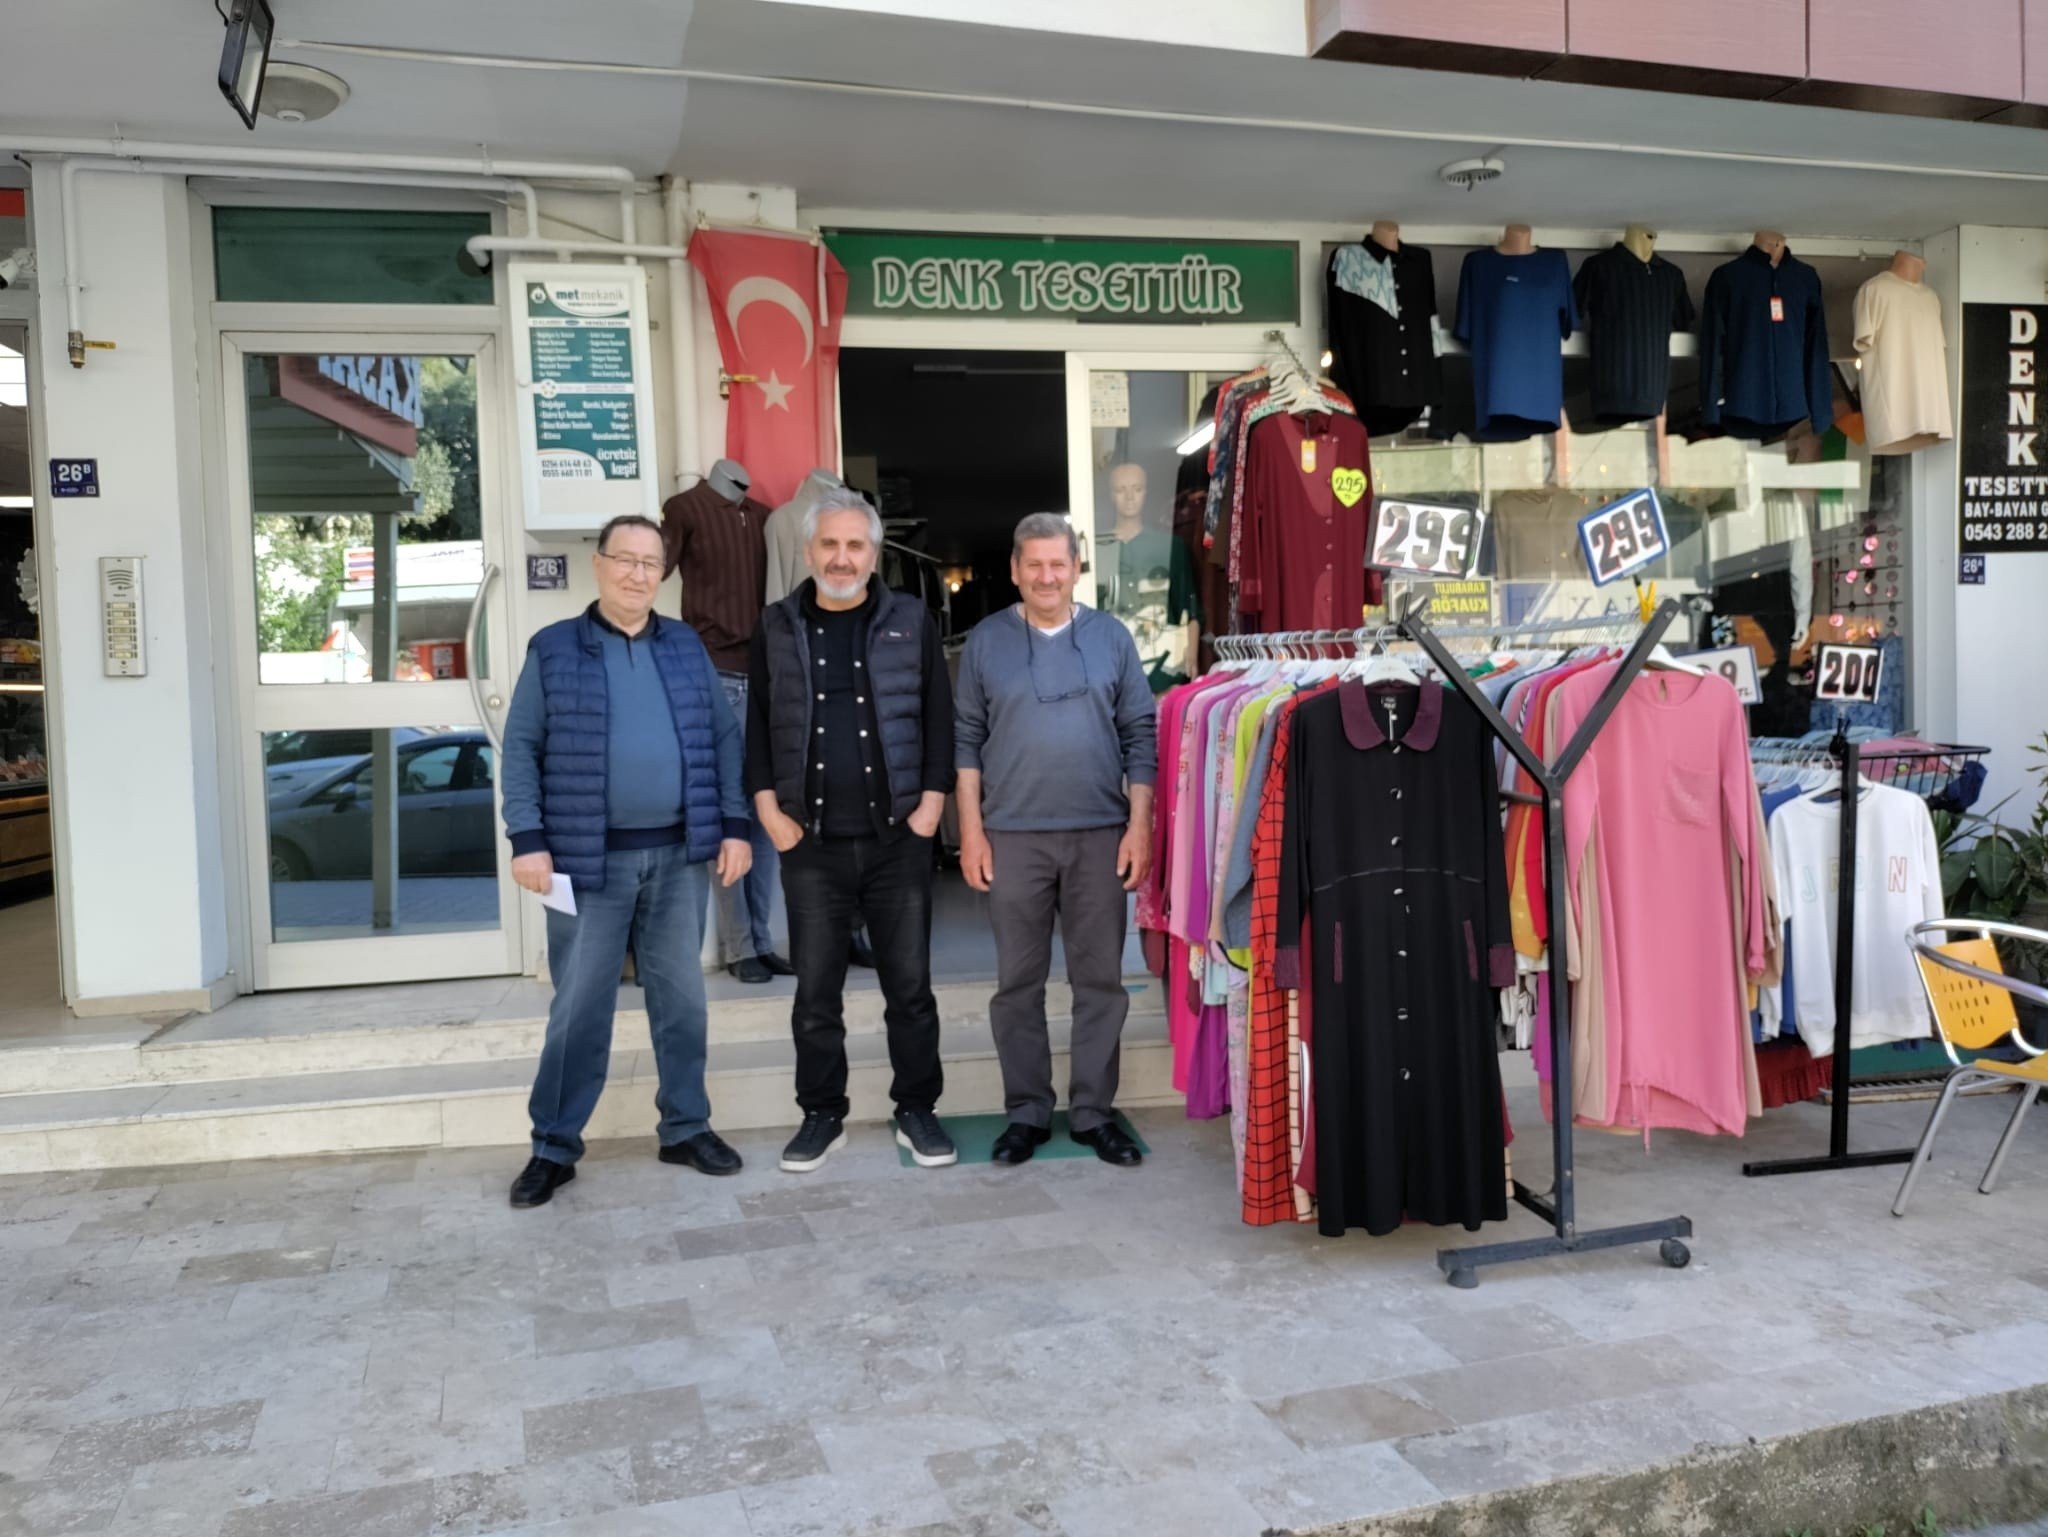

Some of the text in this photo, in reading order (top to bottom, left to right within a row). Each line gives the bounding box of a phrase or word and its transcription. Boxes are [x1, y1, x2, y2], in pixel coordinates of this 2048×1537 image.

[556, 289, 624, 300] met mekanik
[872, 254, 1243, 313] DENK TESETTÜR
[2006, 310, 2039, 466] DENK
[596, 447, 637, 460] ücretsiz
[1378, 504, 1471, 570] 299
[1591, 499, 1661, 577] 299
[1965, 523, 2003, 541] 0543
[2005, 522, 2035, 541] 288
[1822, 652, 1876, 695] 200
